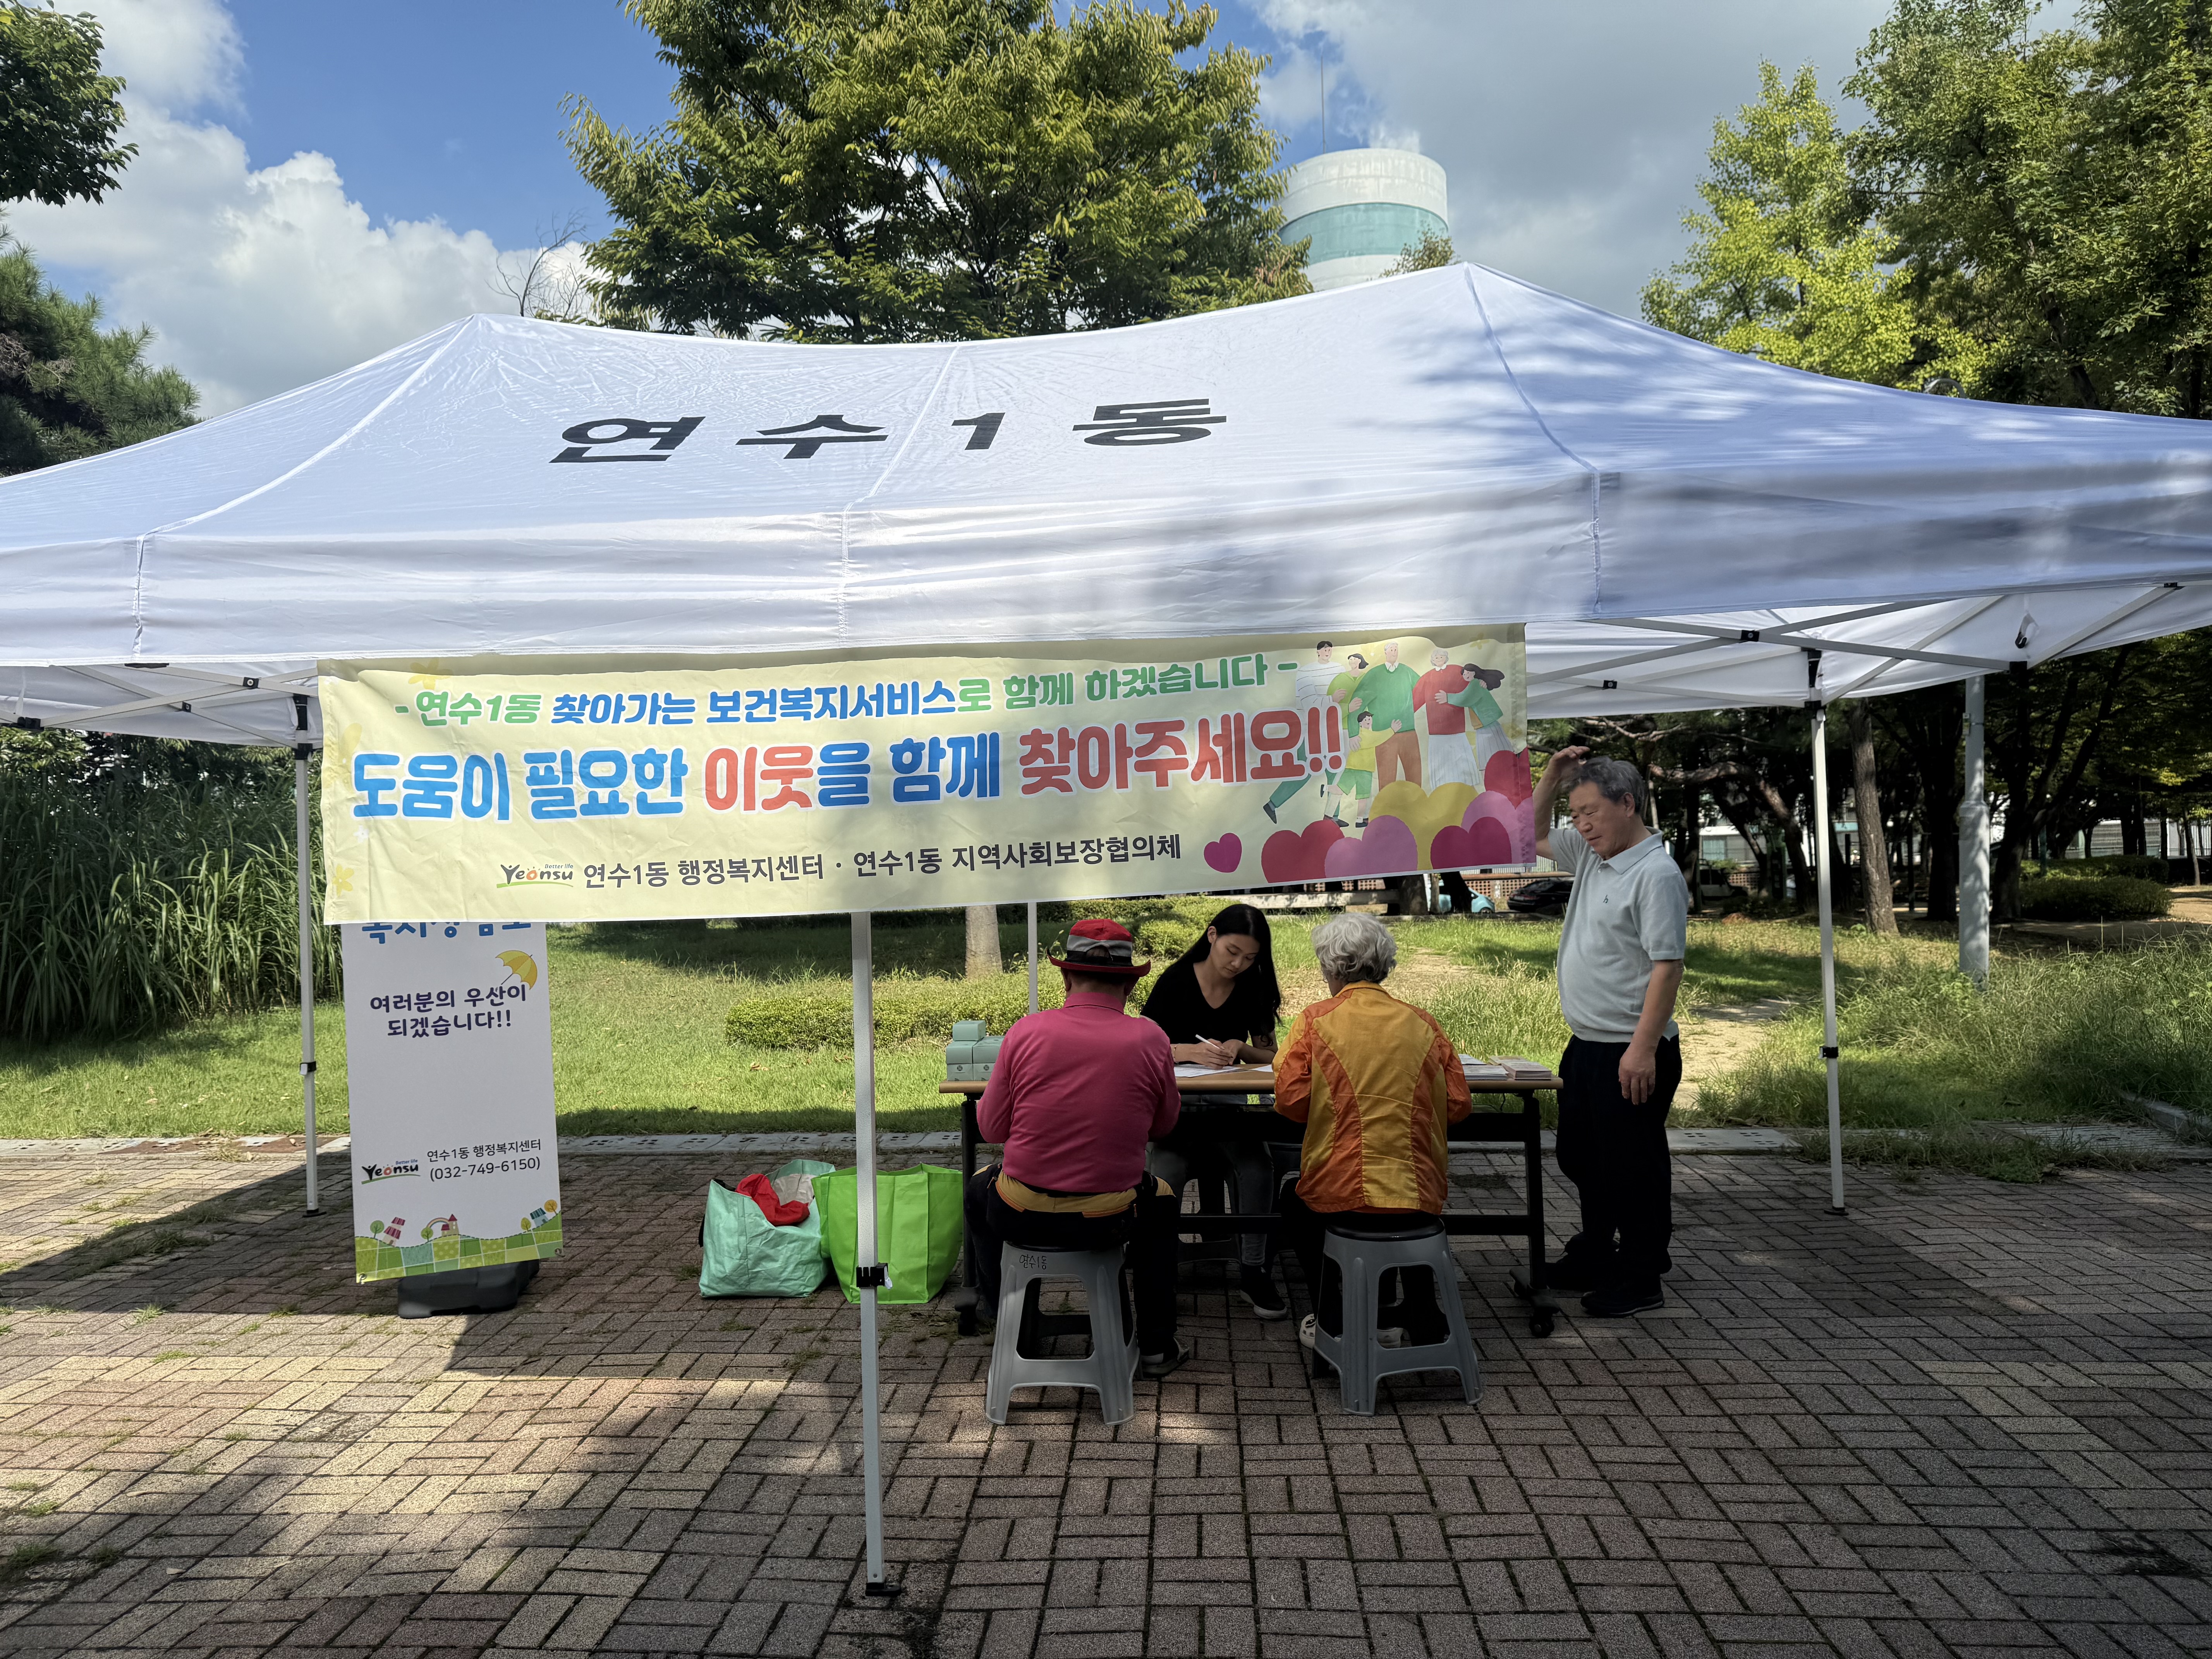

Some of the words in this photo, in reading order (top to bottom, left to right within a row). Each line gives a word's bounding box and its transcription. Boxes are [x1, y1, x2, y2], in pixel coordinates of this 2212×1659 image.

[551, 693, 696, 725] 찾아가는
[707, 680, 990, 723] 보건복지서비스로
[1005, 674, 1073, 709] 함께
[354, 753, 510, 821] 도움이
[524, 748, 688, 820] 필요한
[706, 742, 871, 811] 이웃을
[890, 732, 1000, 803] 함께
[1019, 706, 1342, 795] 찾아주세요!!
[501, 864, 573, 884] Yeonsu
[584, 862, 669, 888] 연수1동
[678, 854, 823, 885] 행정복지센터
[854, 848, 942, 877] 연수1동
[952, 834, 1181, 871] 지역사회보장협의체
[370, 990, 455, 1013] 여러분의
[464, 984, 526, 1007] 우산이
[388, 1010, 511, 1038] 되겠습니다!!
[427, 1147, 470, 1162] 연수1동
[473, 1139, 541, 1158] 행정복지센터
[361, 1164, 419, 1181] Yeonsu
[430, 1156, 540, 1182] (032-749-6150)
